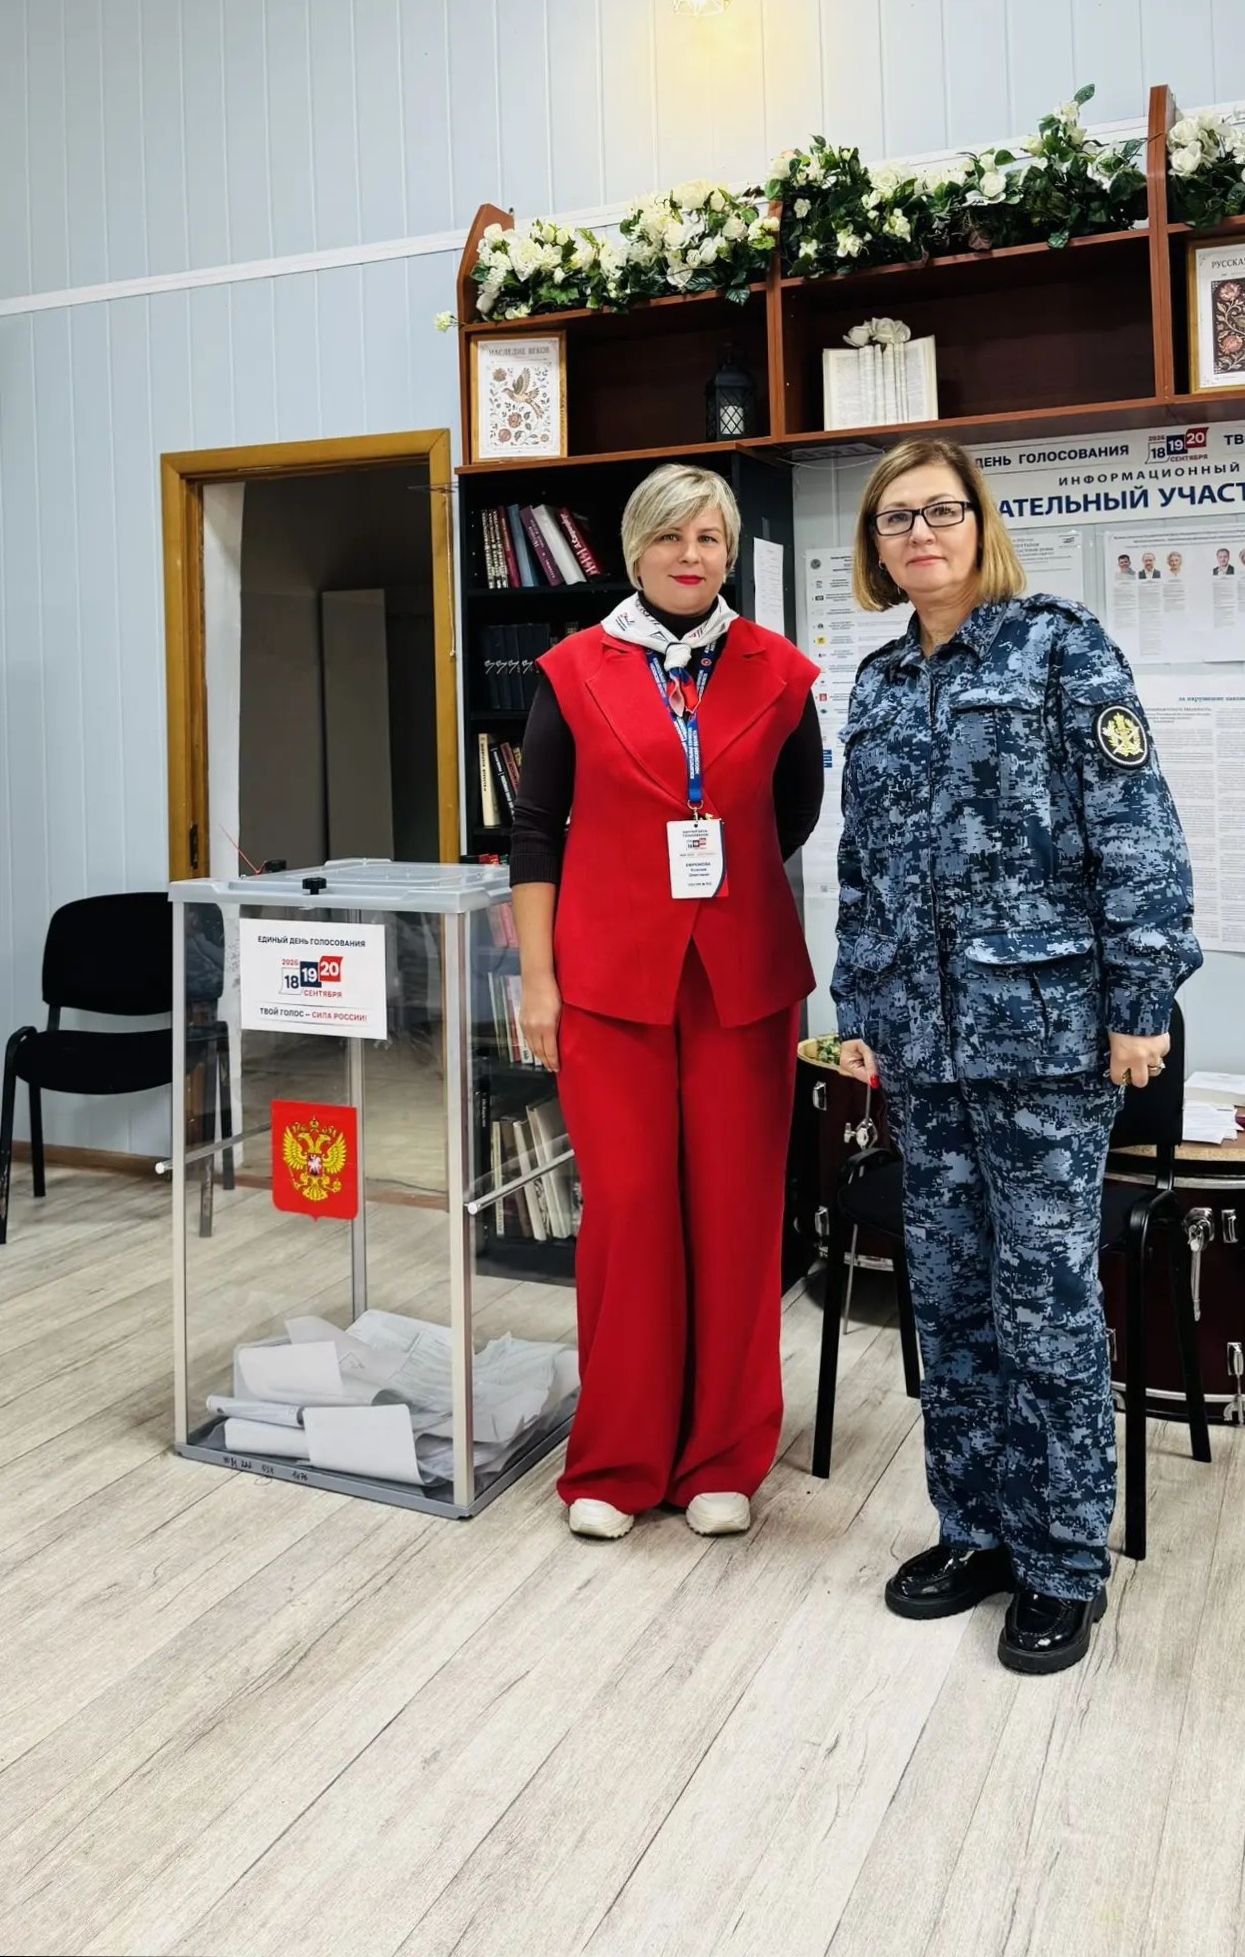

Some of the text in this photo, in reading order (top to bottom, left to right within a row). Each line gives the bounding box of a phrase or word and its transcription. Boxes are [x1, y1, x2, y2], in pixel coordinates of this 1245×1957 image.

[1151, 432, 1205, 459] 18 19 20
[1223, 433, 1245, 446] ТВ
[975, 444, 1130, 469] ДЕНЬ ГОЛОСОВАНИЯ
[1170, 453, 1208, 463] СЕНТЯБРЯ
[1058, 461, 1241, 487] ИНФОРМАЦИОННЫЙ
[999, 482, 1245, 518] АТЕЛЬНЫЙ УЧАСТ
[257, 936, 288, 945] ЕДИНЫЙ
[310, 938, 366, 948] ГОЛОСОВАНИЯ
[284, 961, 339, 989] 18 19 20
[303, 990, 343, 998] СЕНТЯБРЯ
[260, 1006, 279, 1016] ТВОЙ
[280, 1009, 304, 1018] ГОЛОС
[311, 1011, 332, 1020] СИЛА
[333, 1013, 368, 1022] РОССИИ!
